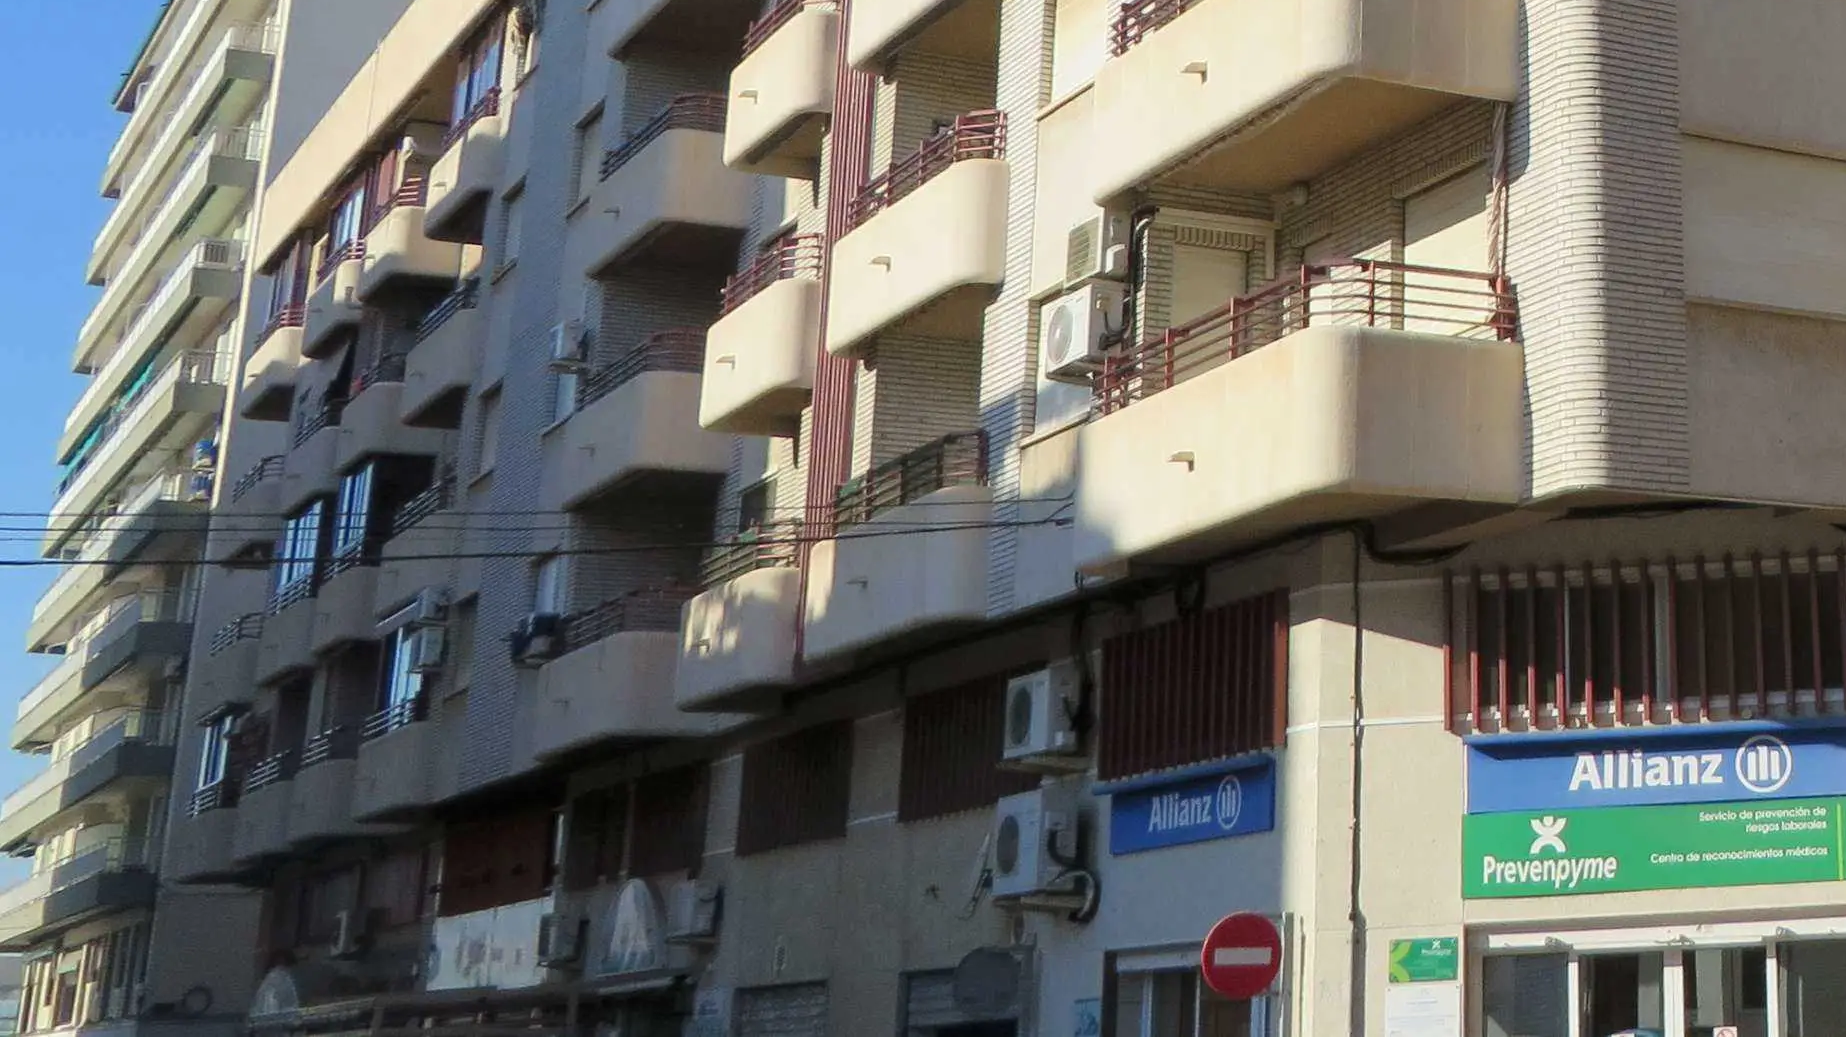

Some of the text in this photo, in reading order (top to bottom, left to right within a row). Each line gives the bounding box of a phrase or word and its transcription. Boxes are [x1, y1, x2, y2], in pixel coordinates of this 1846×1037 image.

[1568, 748, 1724, 791] Allianz
[1148, 792, 1212, 833] Allianz
[1699, 805, 1827, 822] Servicio de prevención de
[1745, 819, 1827, 834] riesgos laborales
[1650, 845, 1828, 864] Centro de reconocimientos médicos
[1483, 855, 1618, 889] Prevenpyme
